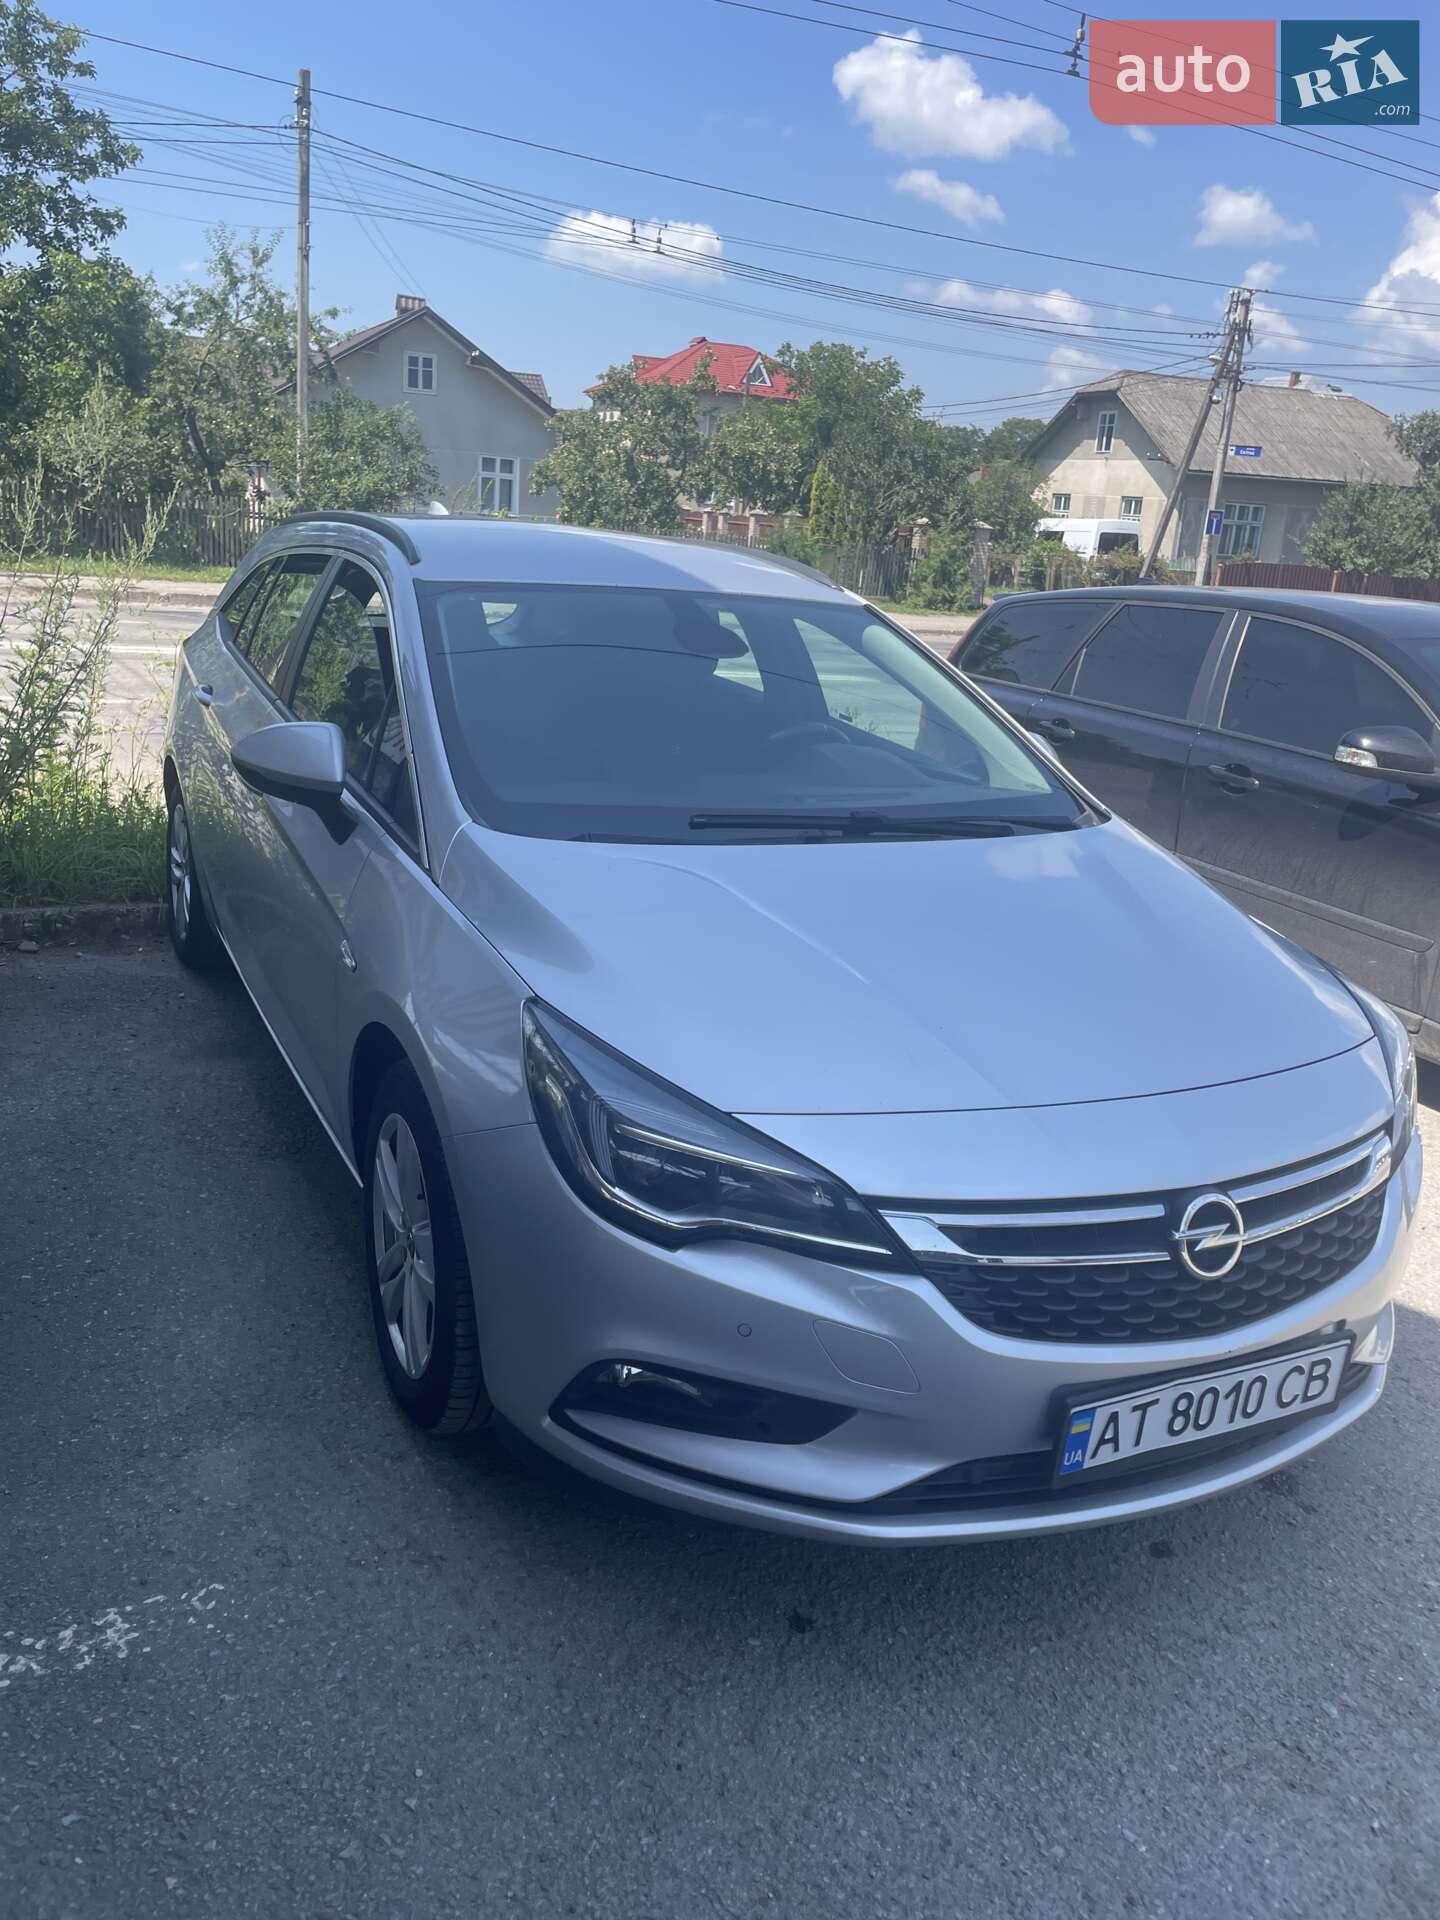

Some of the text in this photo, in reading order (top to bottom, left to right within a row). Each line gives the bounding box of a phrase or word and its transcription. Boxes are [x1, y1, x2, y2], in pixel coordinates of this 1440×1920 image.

[1090, 1357, 1332, 1460] AT 8010 CB
[1064, 1449, 1083, 1466] UA
